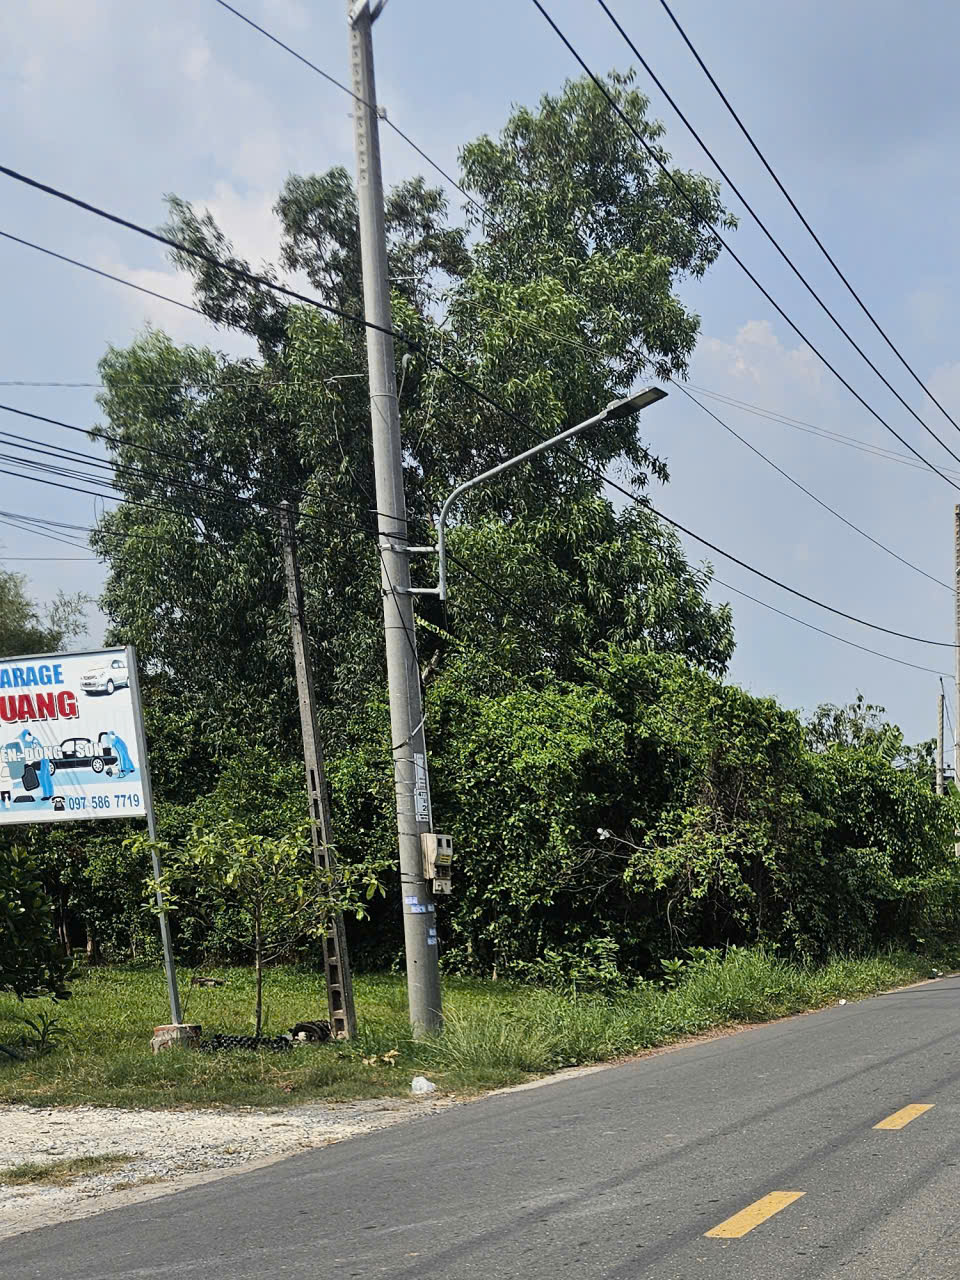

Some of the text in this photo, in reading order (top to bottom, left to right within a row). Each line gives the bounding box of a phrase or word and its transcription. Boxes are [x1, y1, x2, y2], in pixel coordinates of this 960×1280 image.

[0, 664, 64, 688] ARAGE
[0, 690, 79, 723] UANG
[68, 793, 140, 810] 097 586 7719
